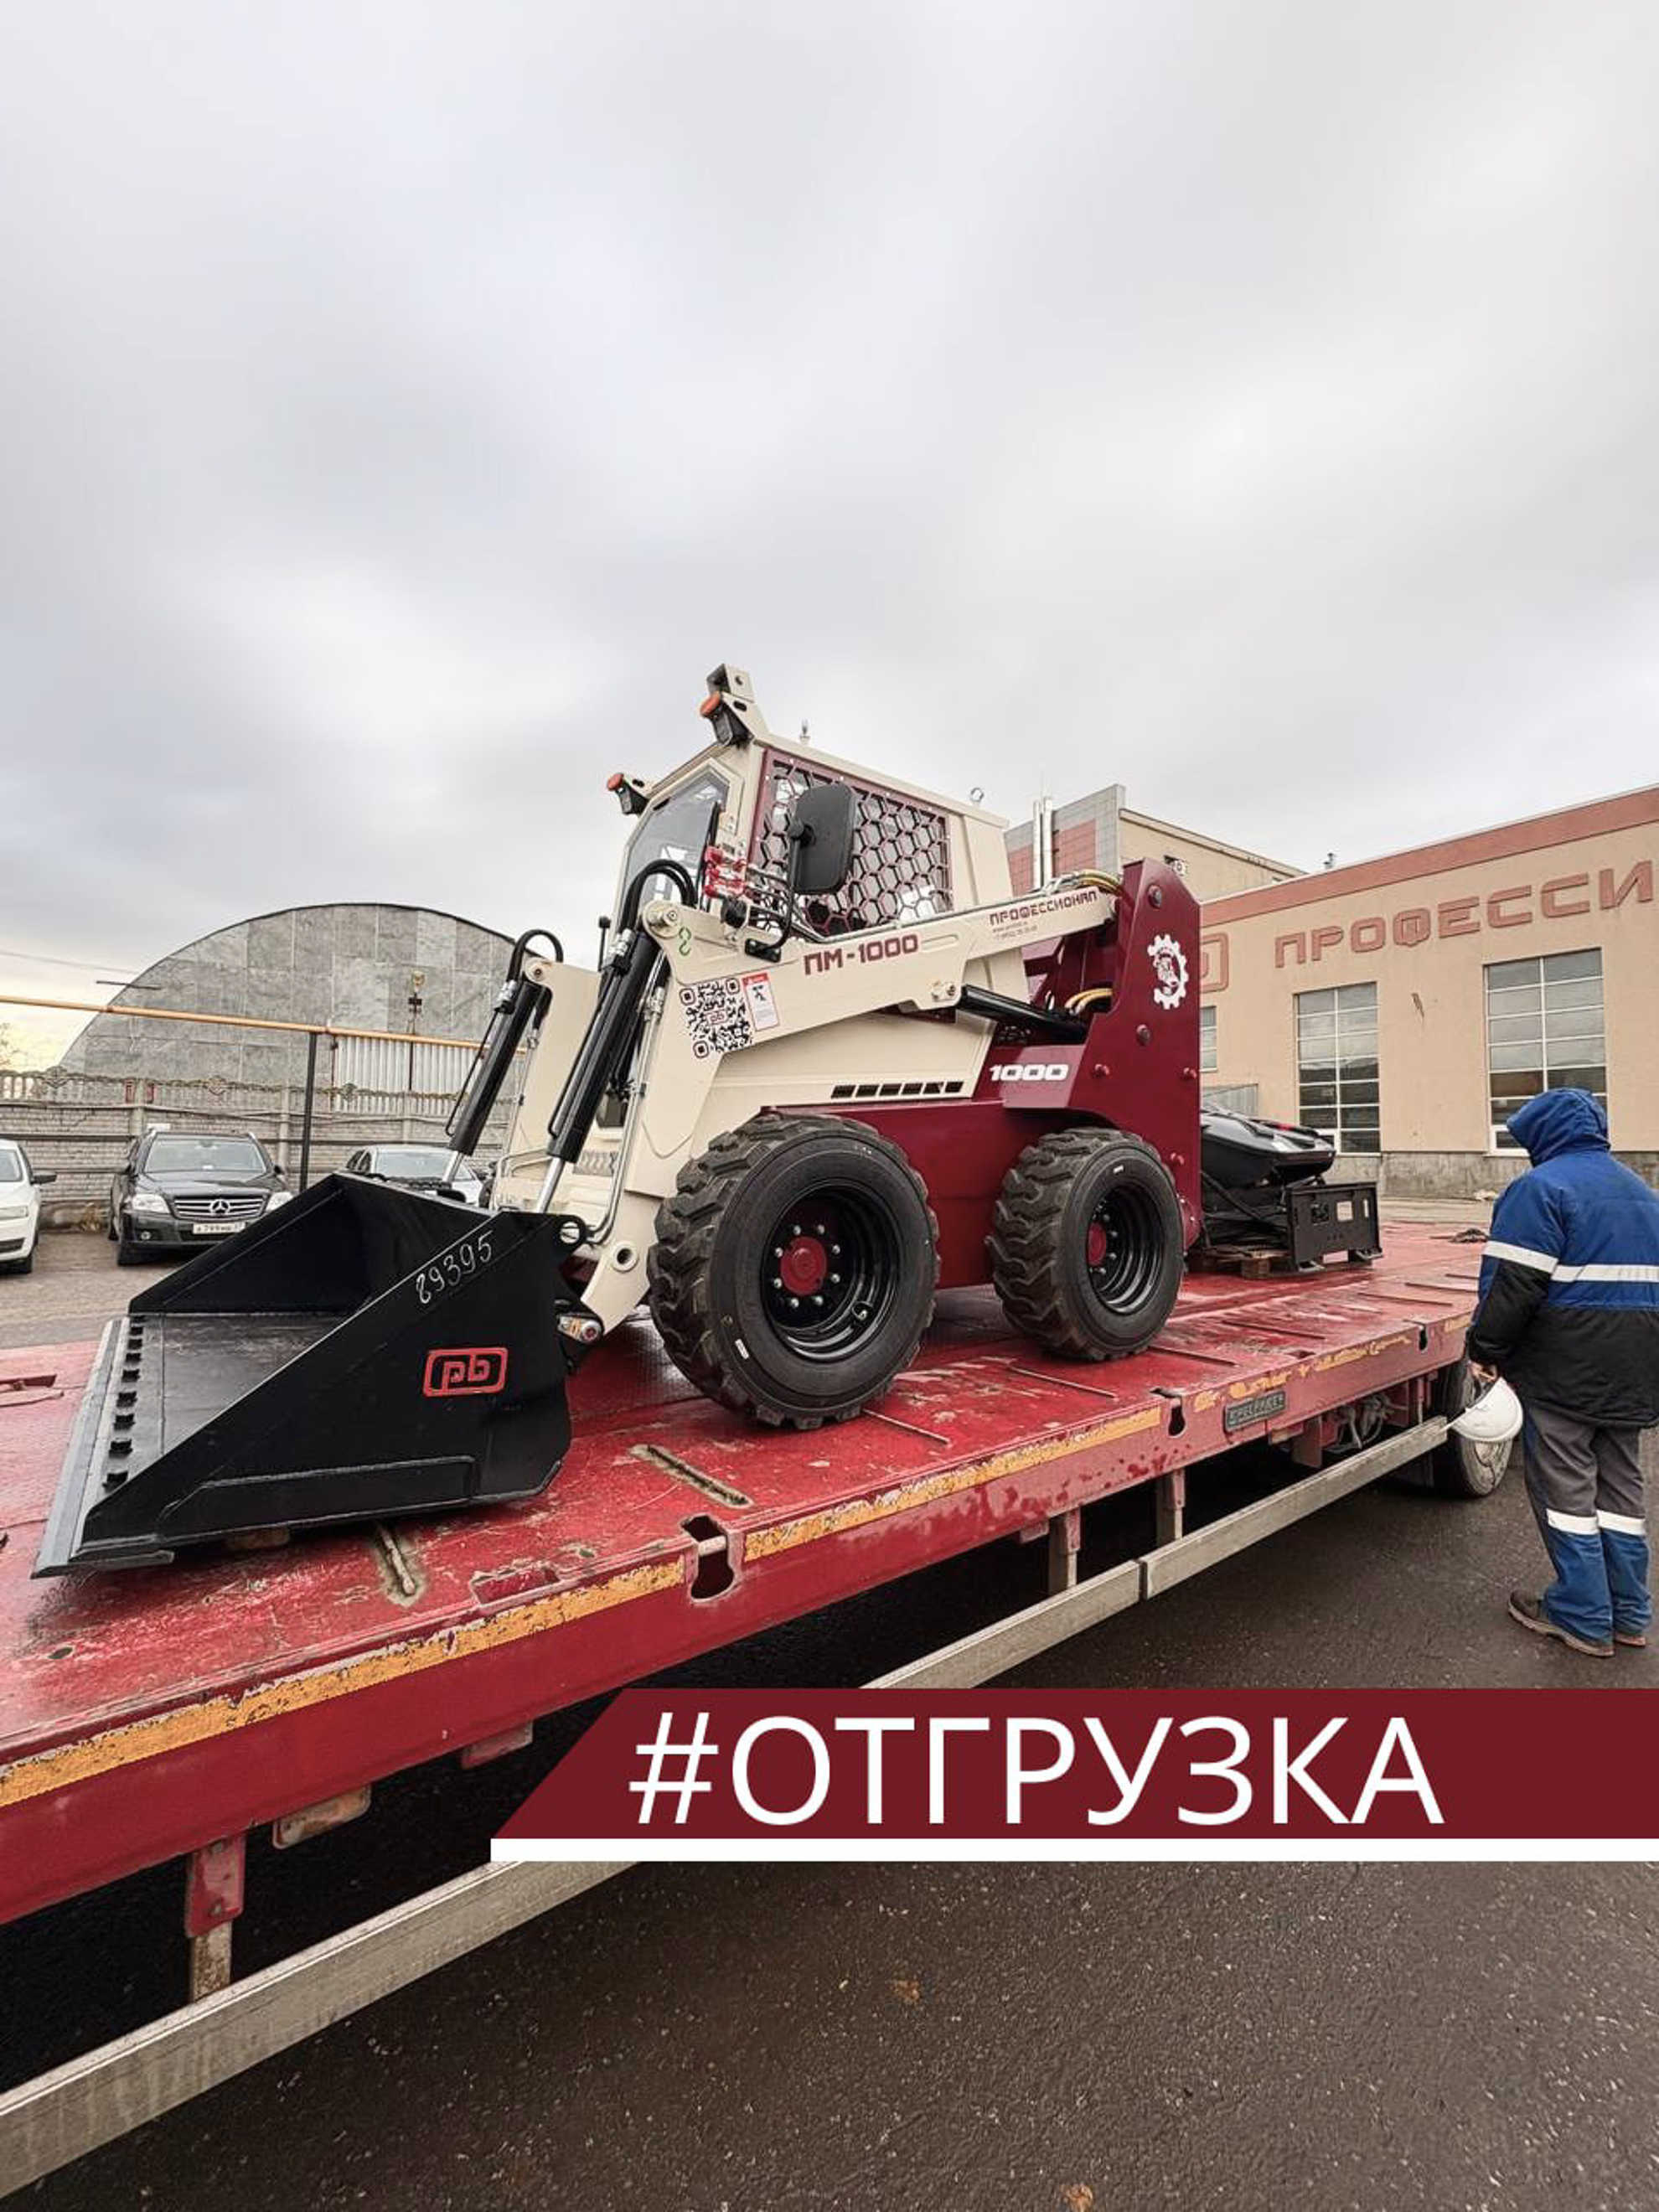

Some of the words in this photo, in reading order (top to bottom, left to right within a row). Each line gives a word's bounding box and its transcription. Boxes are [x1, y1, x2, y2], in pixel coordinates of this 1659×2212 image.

[990, 890, 1098, 926] ПРОФЕССИОНАЛ
[1274, 860, 1653, 969] ПРОФЕССИ
[804, 934, 918, 975] ПМ-1000
[990, 1064, 1069, 1082] 1000
